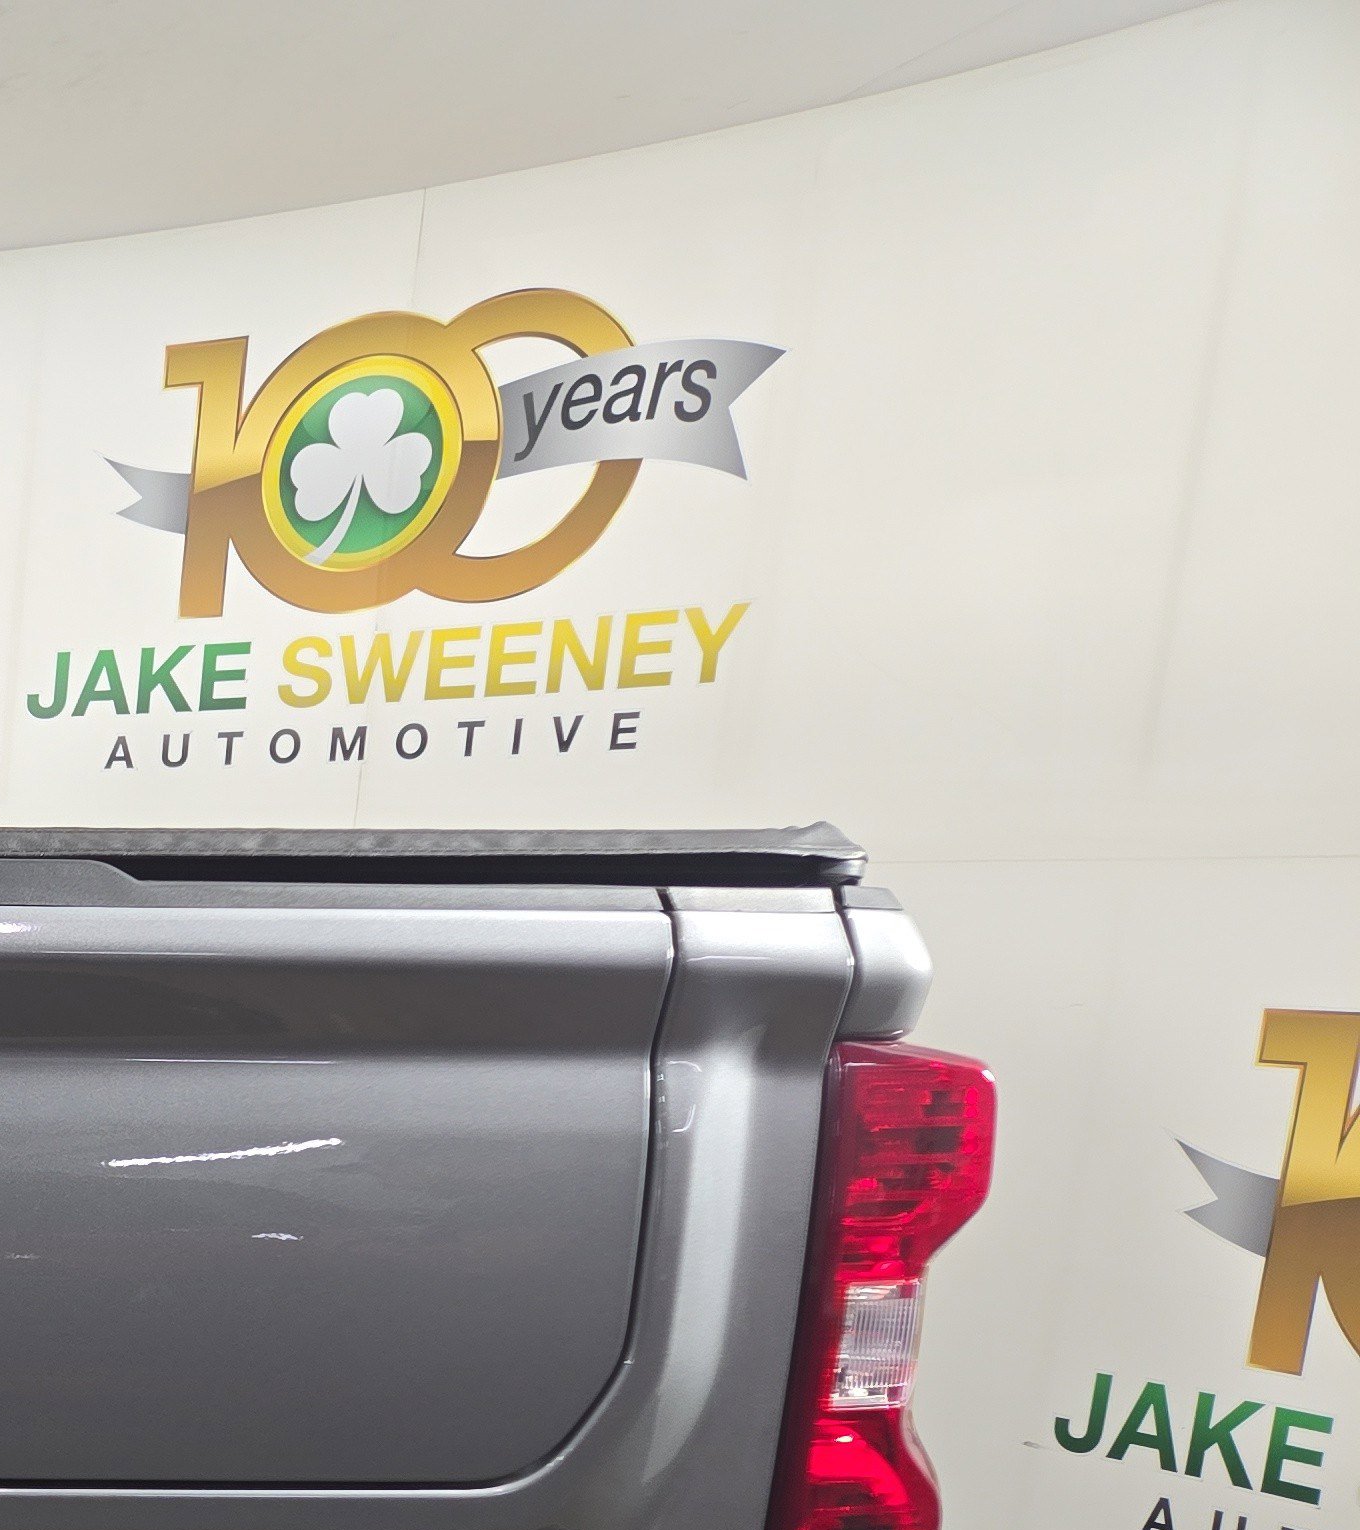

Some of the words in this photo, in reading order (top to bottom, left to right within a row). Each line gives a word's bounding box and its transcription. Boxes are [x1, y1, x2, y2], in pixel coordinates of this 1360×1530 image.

[514, 358, 717, 461] years
[26, 641, 252, 719] JAKE
[277, 602, 750, 709] SWEENEY
[104, 712, 641, 770] AUTOMOTIVE
[1053, 1372, 1335, 1506] JAKE
